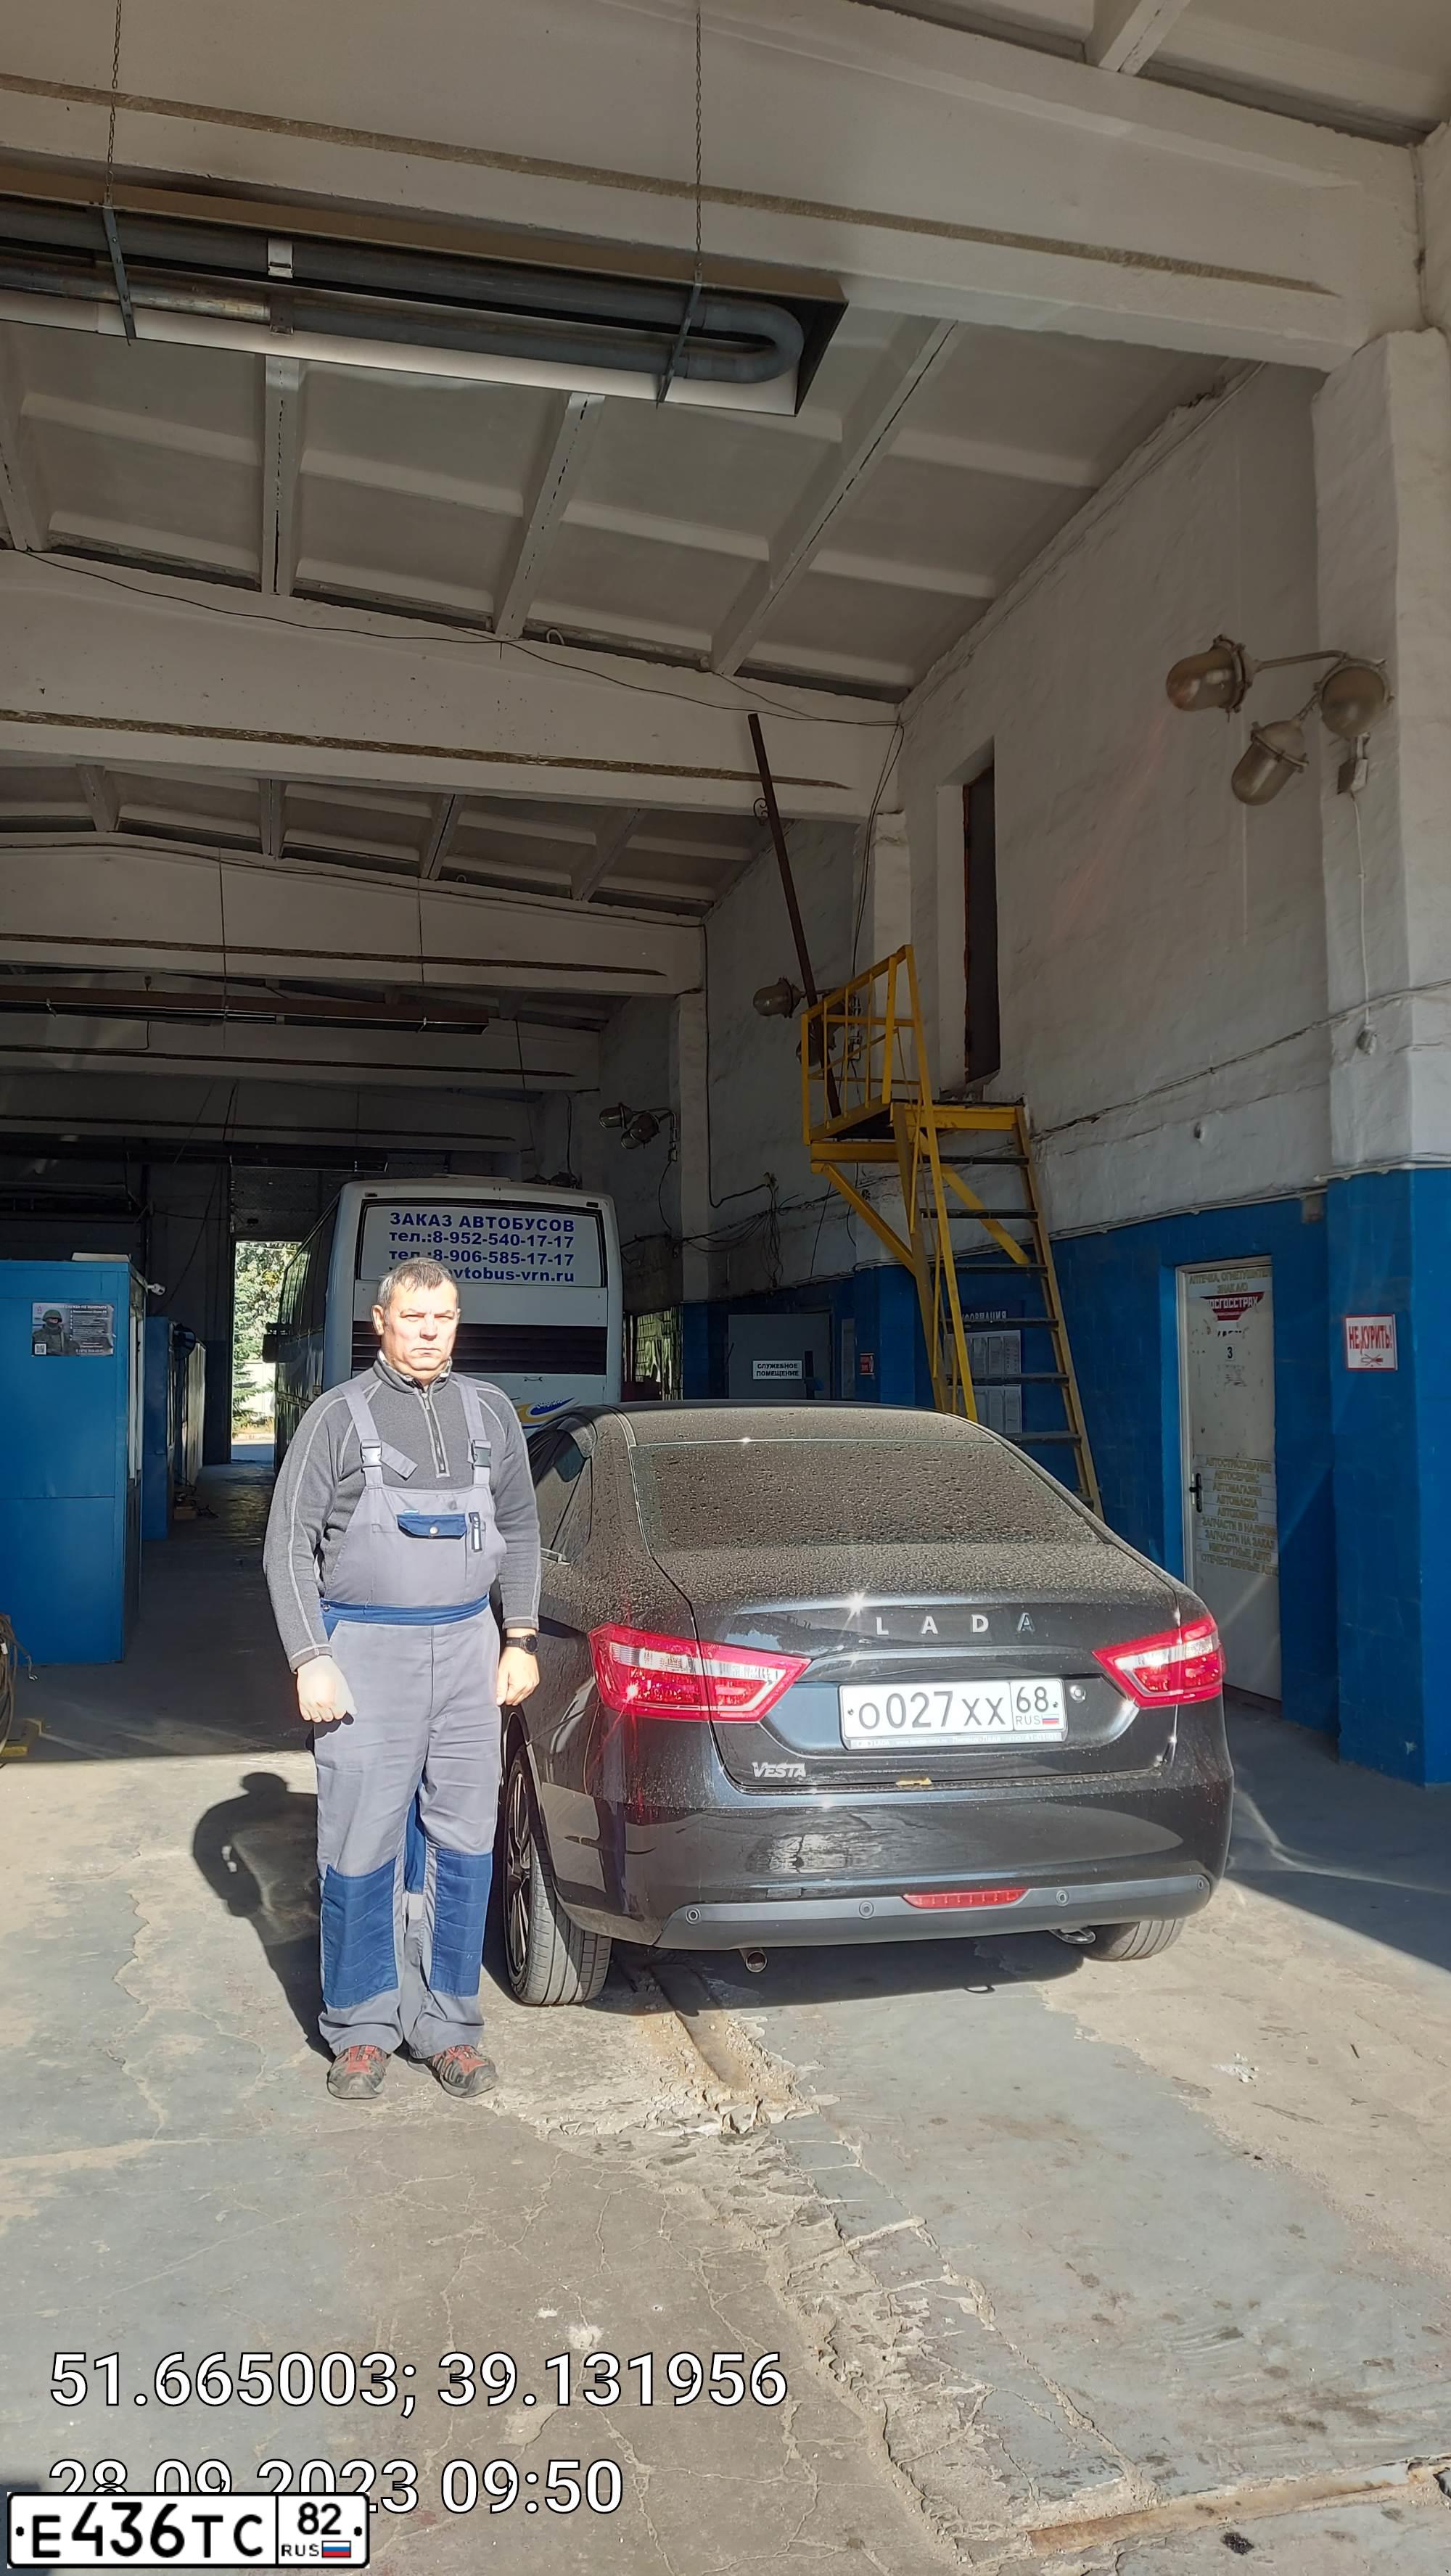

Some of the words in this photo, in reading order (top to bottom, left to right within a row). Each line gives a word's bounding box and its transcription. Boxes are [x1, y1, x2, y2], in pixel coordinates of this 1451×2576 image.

[390, 1212, 453, 1227] ЗАКАЗ
[459, 1215, 575, 1233] АВТОБУСОВ
[389, 1230, 575, 1248] тел.:8-952-540-17-17
[389, 1249, 575, 1267] тел:8-906-585-17-17
[1209, 1296, 1259, 1309] ОСГОССТРАХ
[1349, 1325, 1360, 1349] НЕ
[1361, 1324, 1393, 1349] КУРИТЬ!
[1227, 1346, 1233, 1359] 3
[1201, 1516, 1237, 1531] ЗАПЧАСТИ
[1205, 1529, 1240, 1544] ЗАПЧАСТИ
[1241, 1535, 1252, 1546] НА
[876, 1613, 1036, 1636] LADA
[1016, 1686, 1049, 1713] 68
[1016, 1716, 1041, 1726] RUS
[752, 1761, 807, 1778] VESTA
